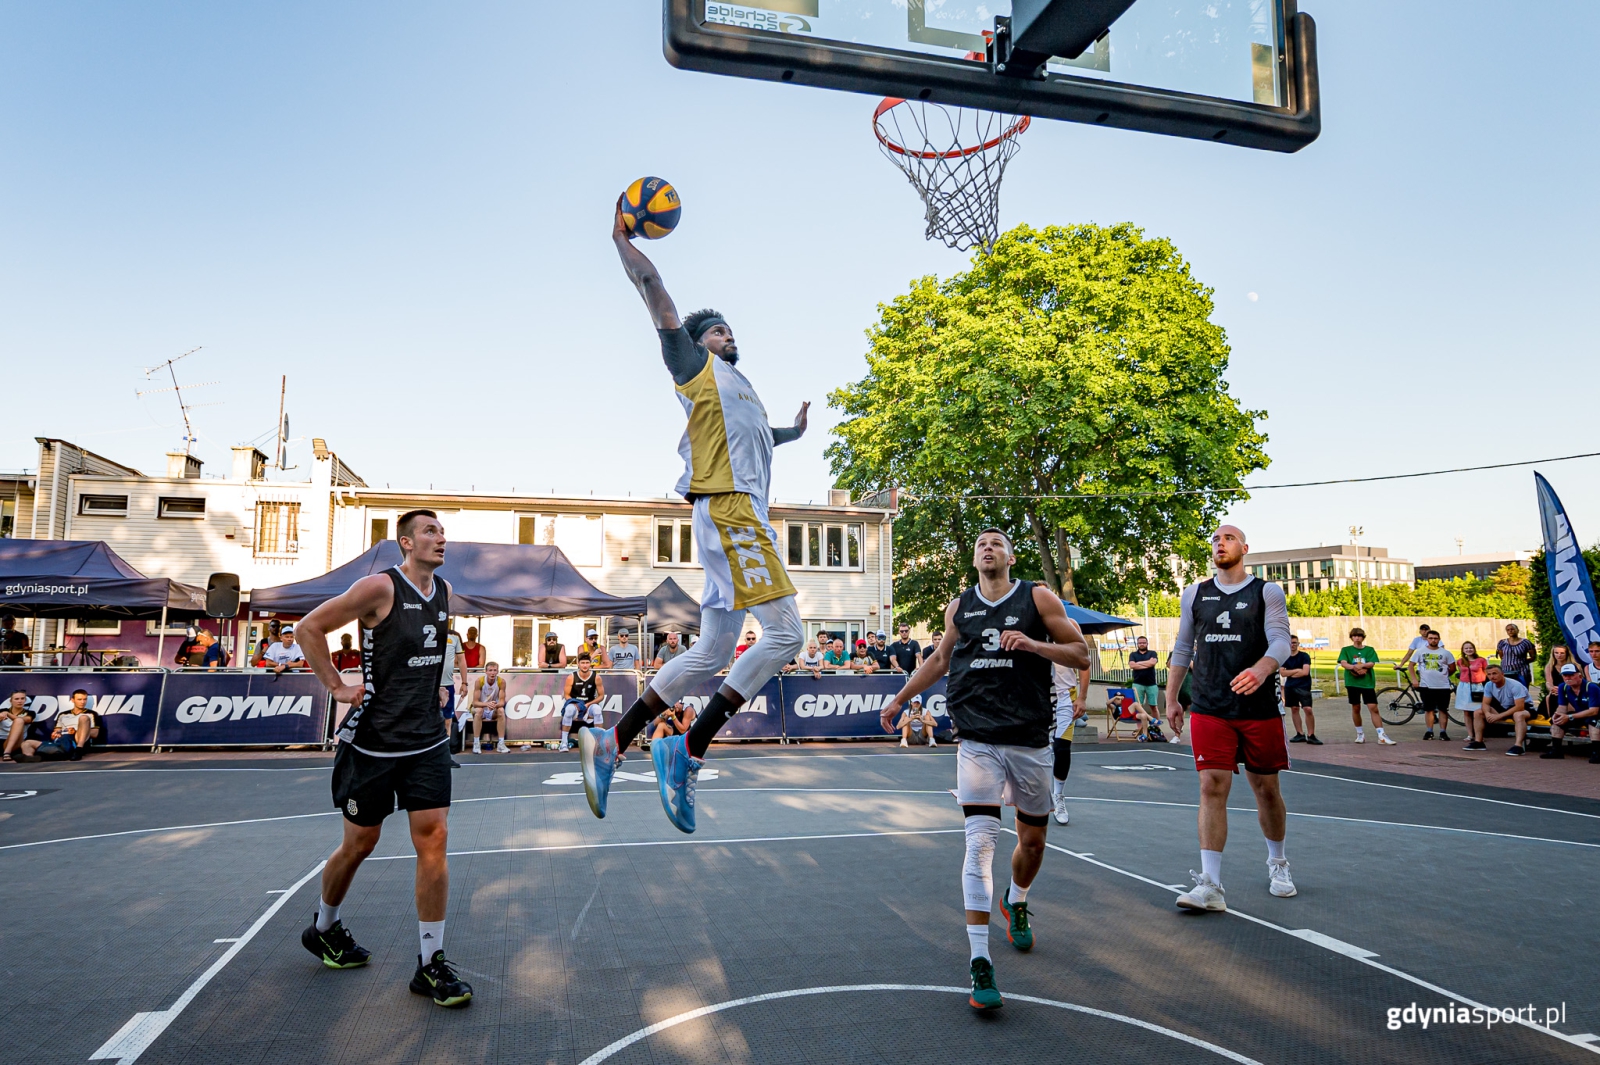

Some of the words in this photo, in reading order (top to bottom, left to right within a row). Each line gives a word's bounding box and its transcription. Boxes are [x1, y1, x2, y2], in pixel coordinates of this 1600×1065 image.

[5, 583, 89, 596] gdyniasport.pl
[1216, 610, 1231, 629] 4
[423, 624, 437, 648] 2
[981, 628, 1000, 651] 3
[1205, 633, 1242, 642] GDYNIA
[970, 659, 1013, 669] GDYNIA
[175, 695, 313, 724] GDYNIA
